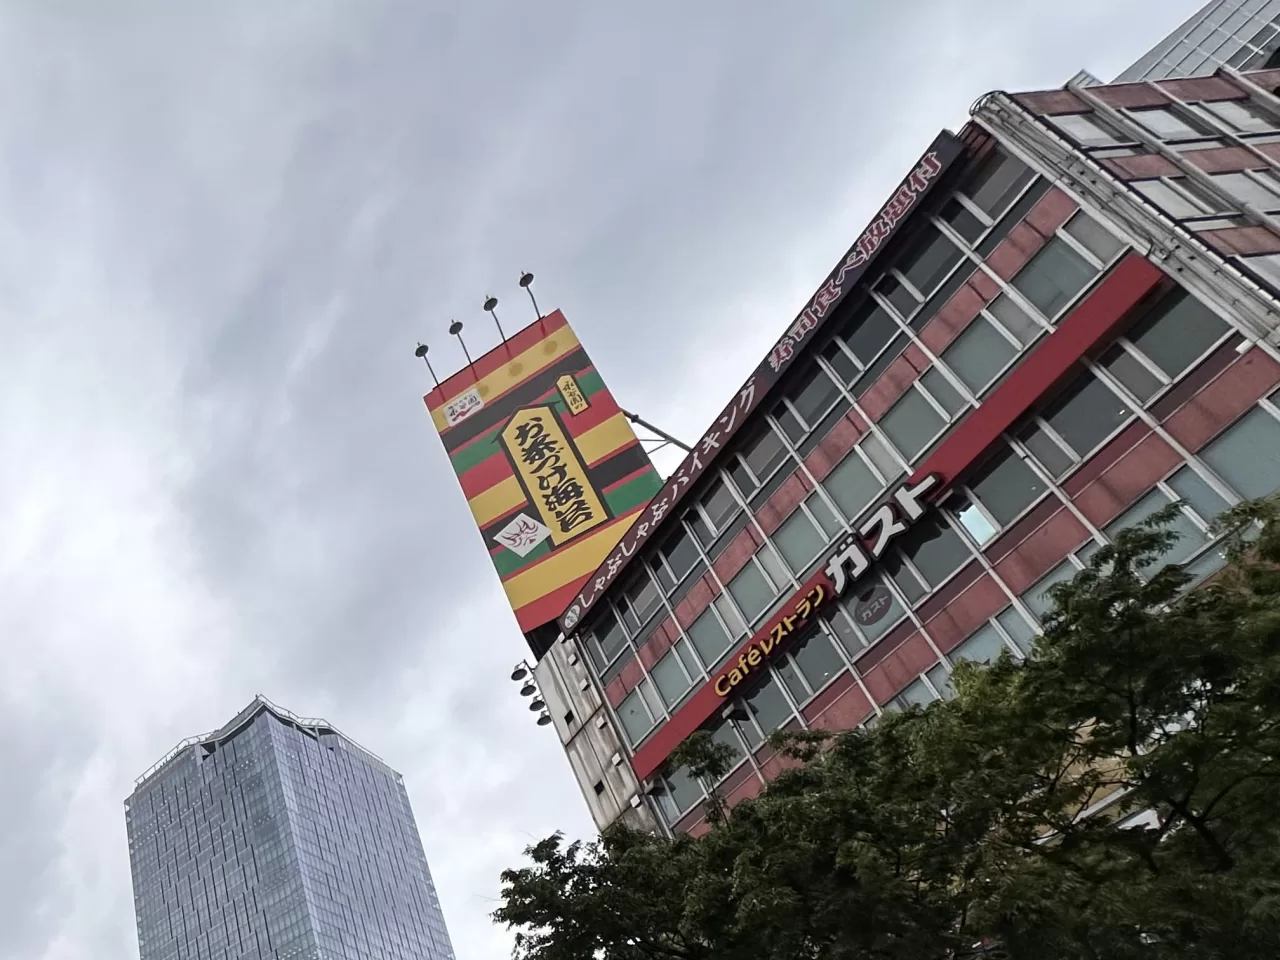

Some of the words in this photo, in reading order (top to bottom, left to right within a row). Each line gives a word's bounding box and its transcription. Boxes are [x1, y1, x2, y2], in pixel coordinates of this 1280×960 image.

[514, 417, 593, 533] お茶づけ海苔
[579, 376, 756, 608] しゃぶしゃぶバイキング
[825, 475, 936, 594] ガスト
[861, 595, 890, 621] ガスト
